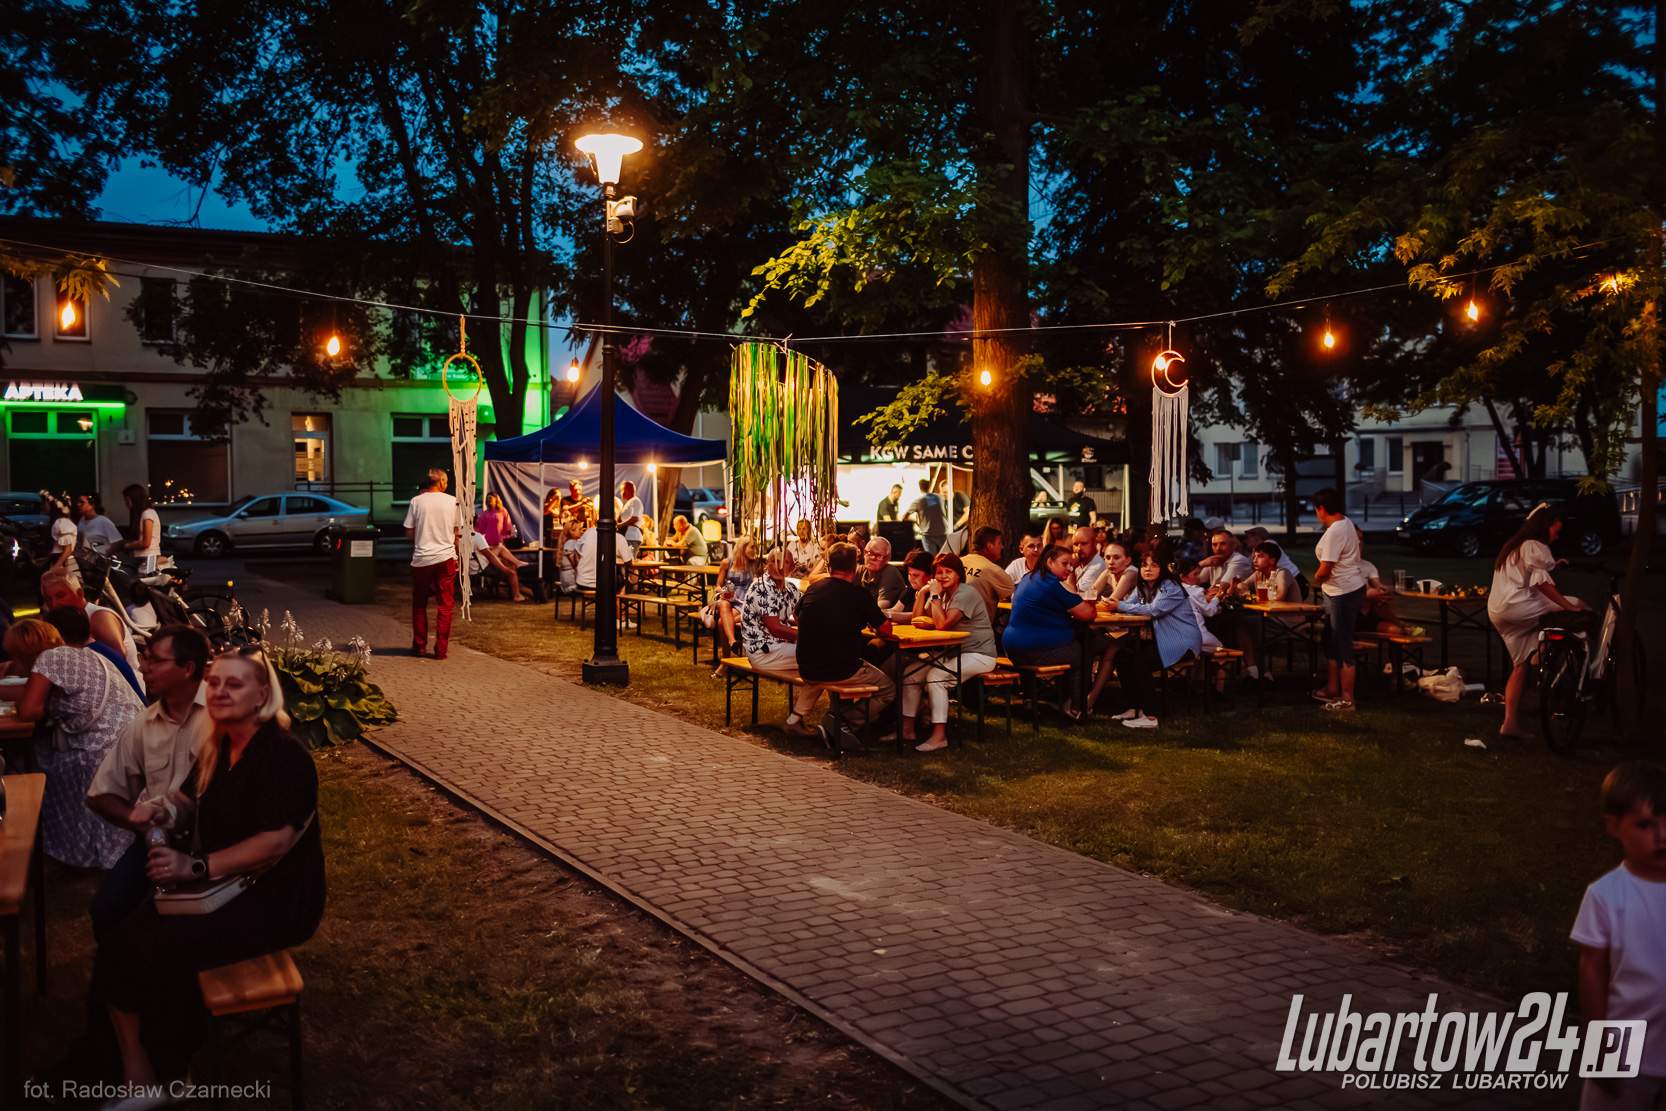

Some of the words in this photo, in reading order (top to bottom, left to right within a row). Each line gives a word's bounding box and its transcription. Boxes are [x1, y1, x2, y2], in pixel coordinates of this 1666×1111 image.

[4, 381, 83, 402] APTEKA
[870, 445, 909, 460] KGW
[912, 444, 958, 459] SAME
